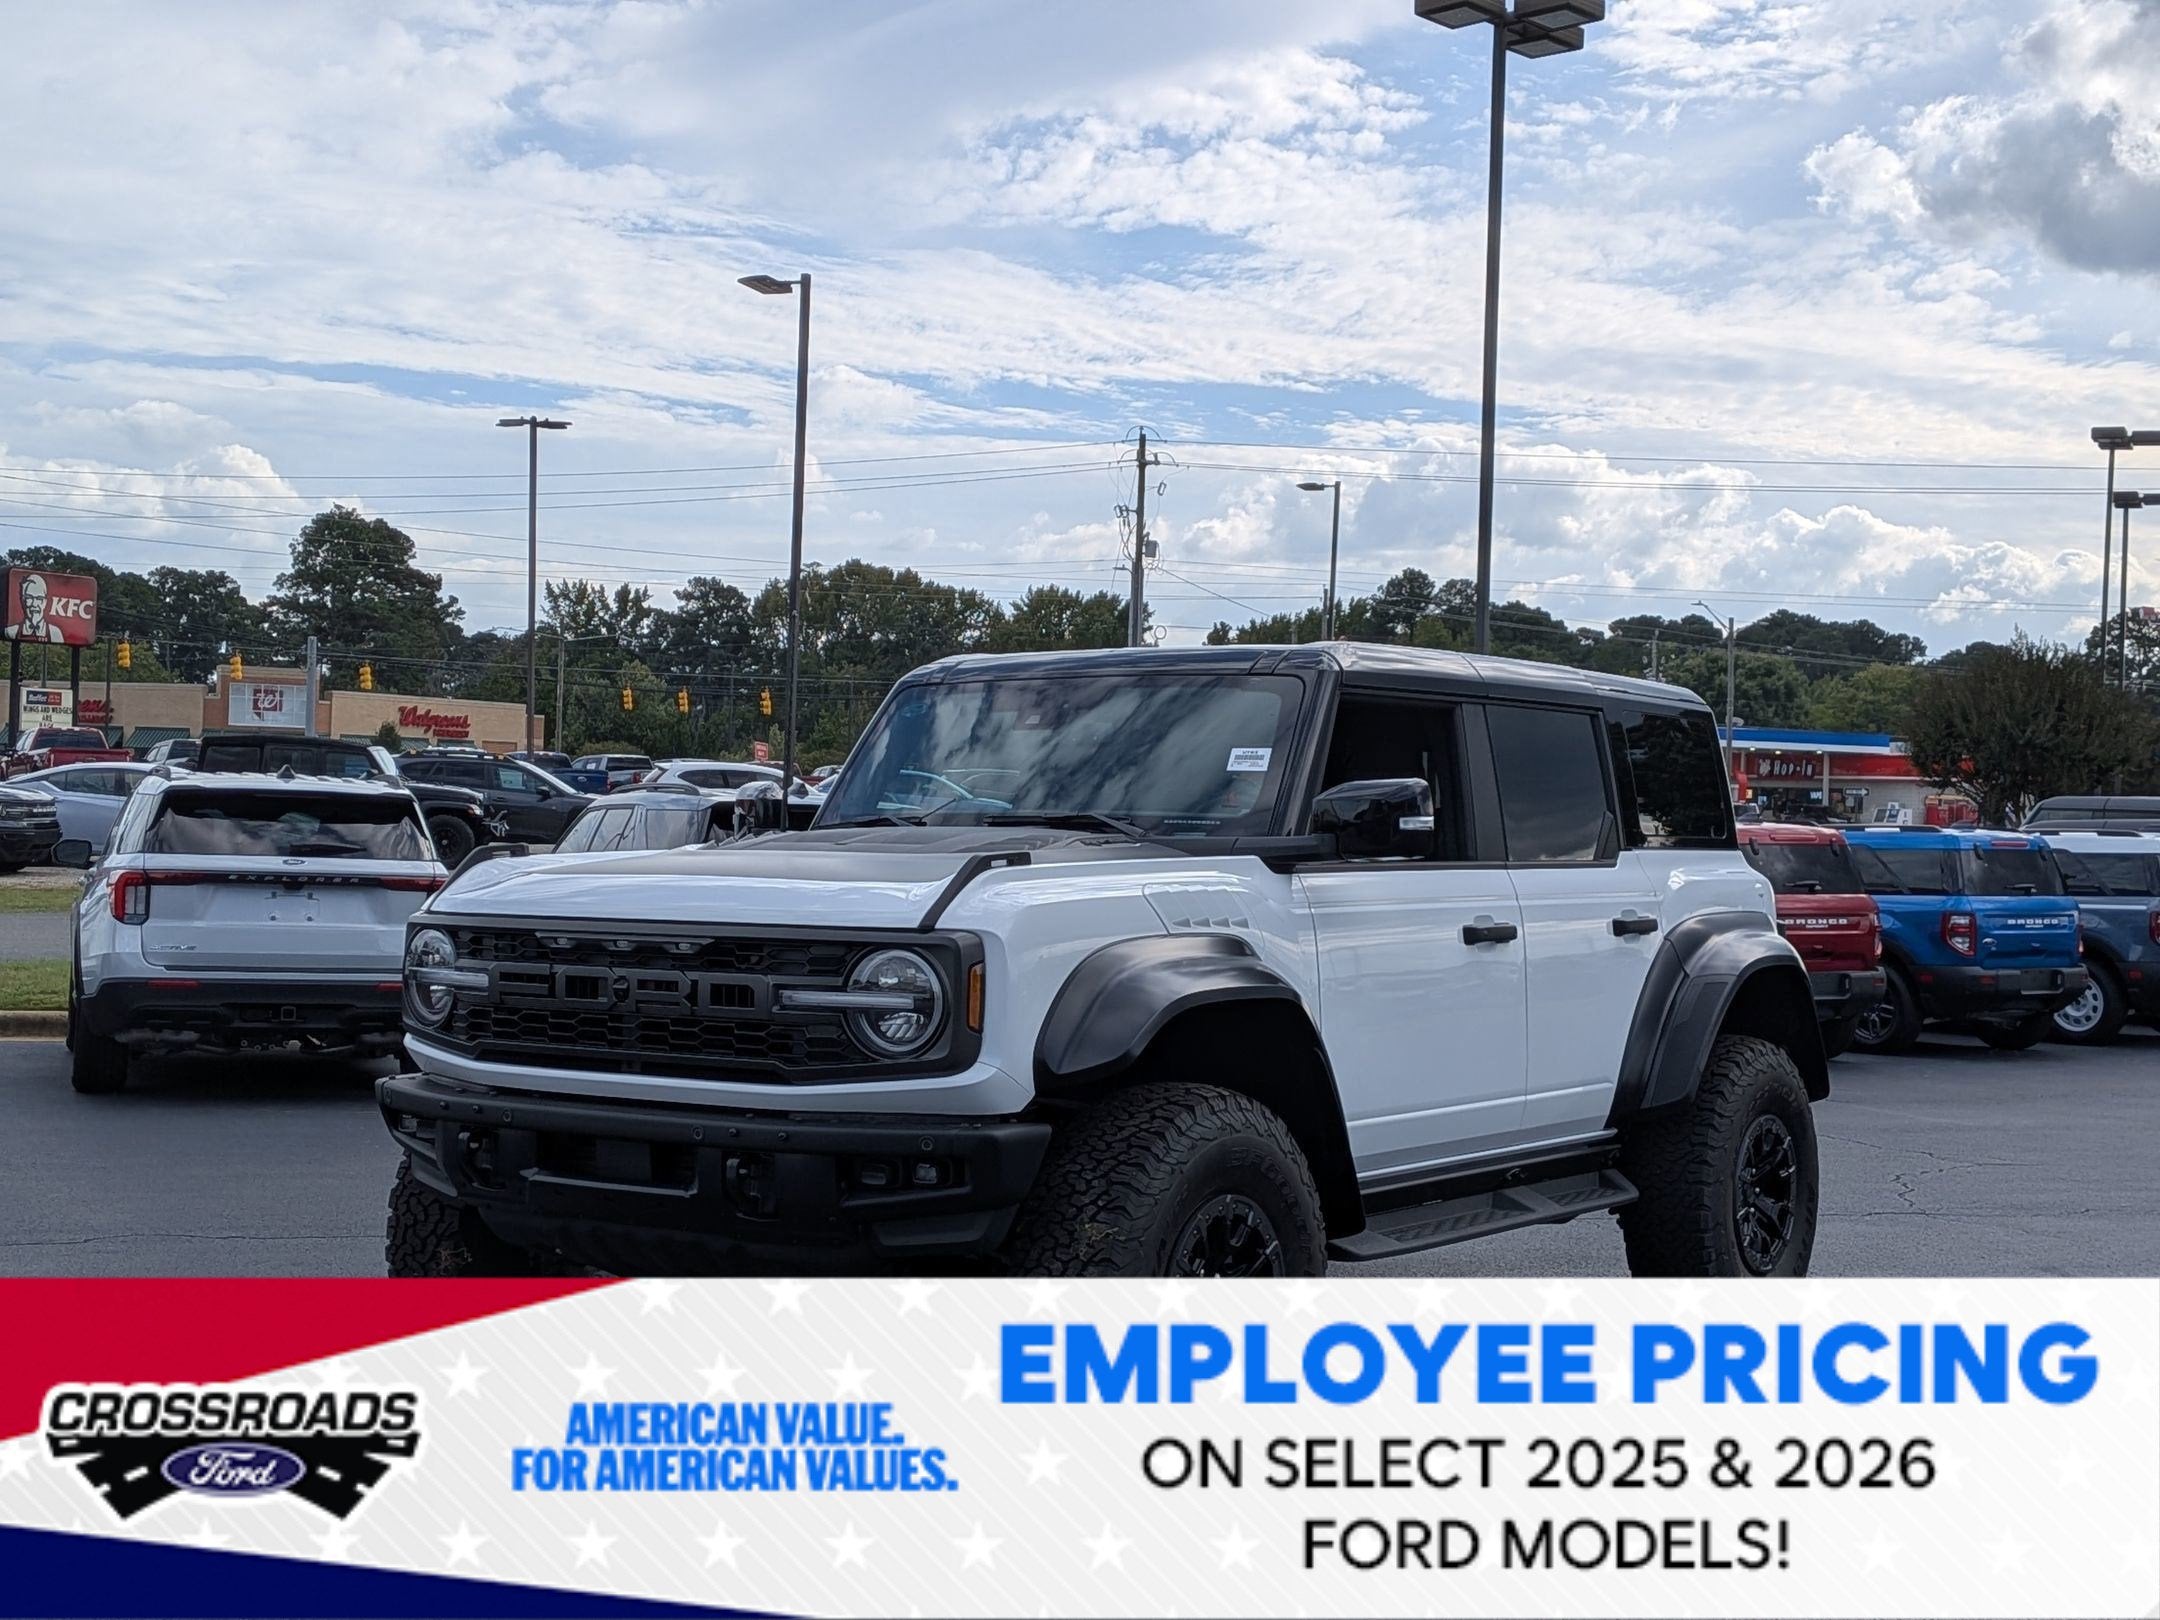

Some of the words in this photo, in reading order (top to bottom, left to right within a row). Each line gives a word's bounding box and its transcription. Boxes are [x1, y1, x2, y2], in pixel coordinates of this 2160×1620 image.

[49, 596, 94, 620] KFC
[398, 705, 471, 734] Walgreens
[228, 874, 360, 883] EXPLORER
[488, 962, 771, 1020] FORD
